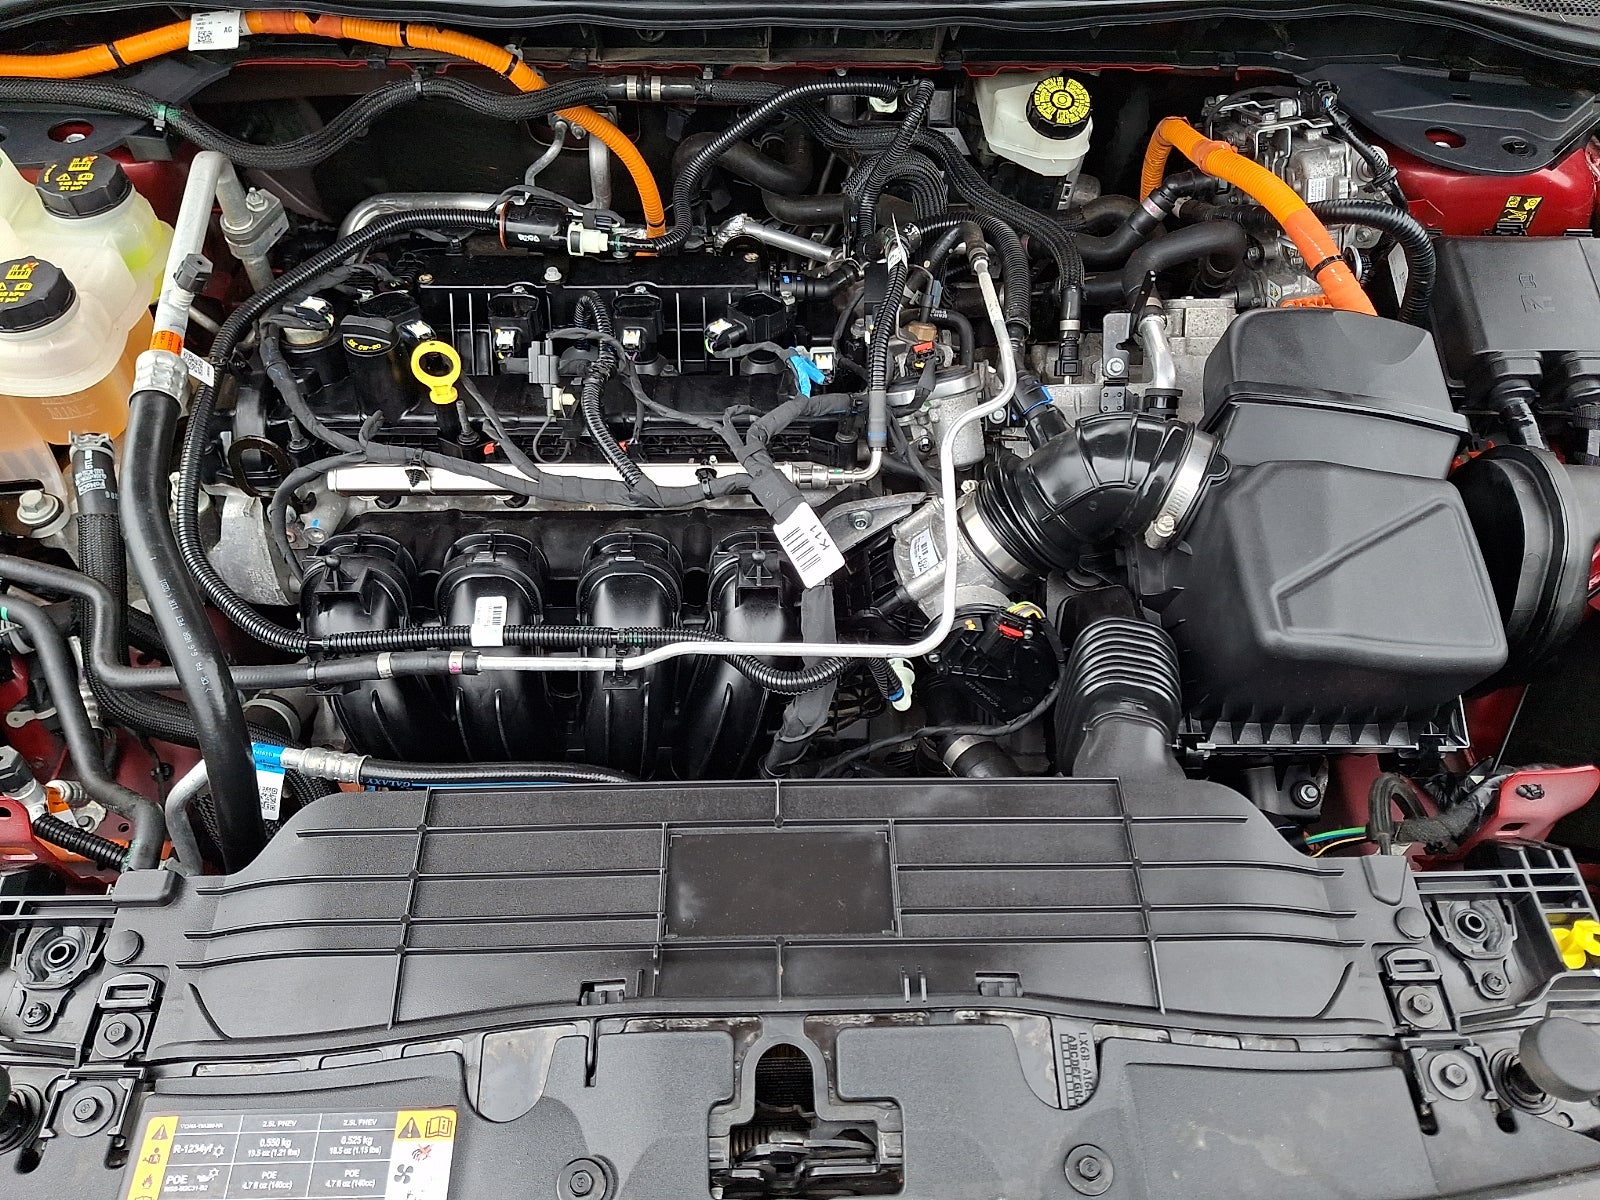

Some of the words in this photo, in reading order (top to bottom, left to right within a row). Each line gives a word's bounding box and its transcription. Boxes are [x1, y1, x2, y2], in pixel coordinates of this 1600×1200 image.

[810, 525, 830, 551] K11
[367, 778, 411, 787] GALAXY
[281, 1138, 292, 1148] kg
[362, 1135, 374, 1146] kg
[173, 1144, 213, 1155] R-1234yf
[261, 1171, 277, 1179] POE
[344, 1169, 360, 1177] POE
[165, 1174, 188, 1185] POE
